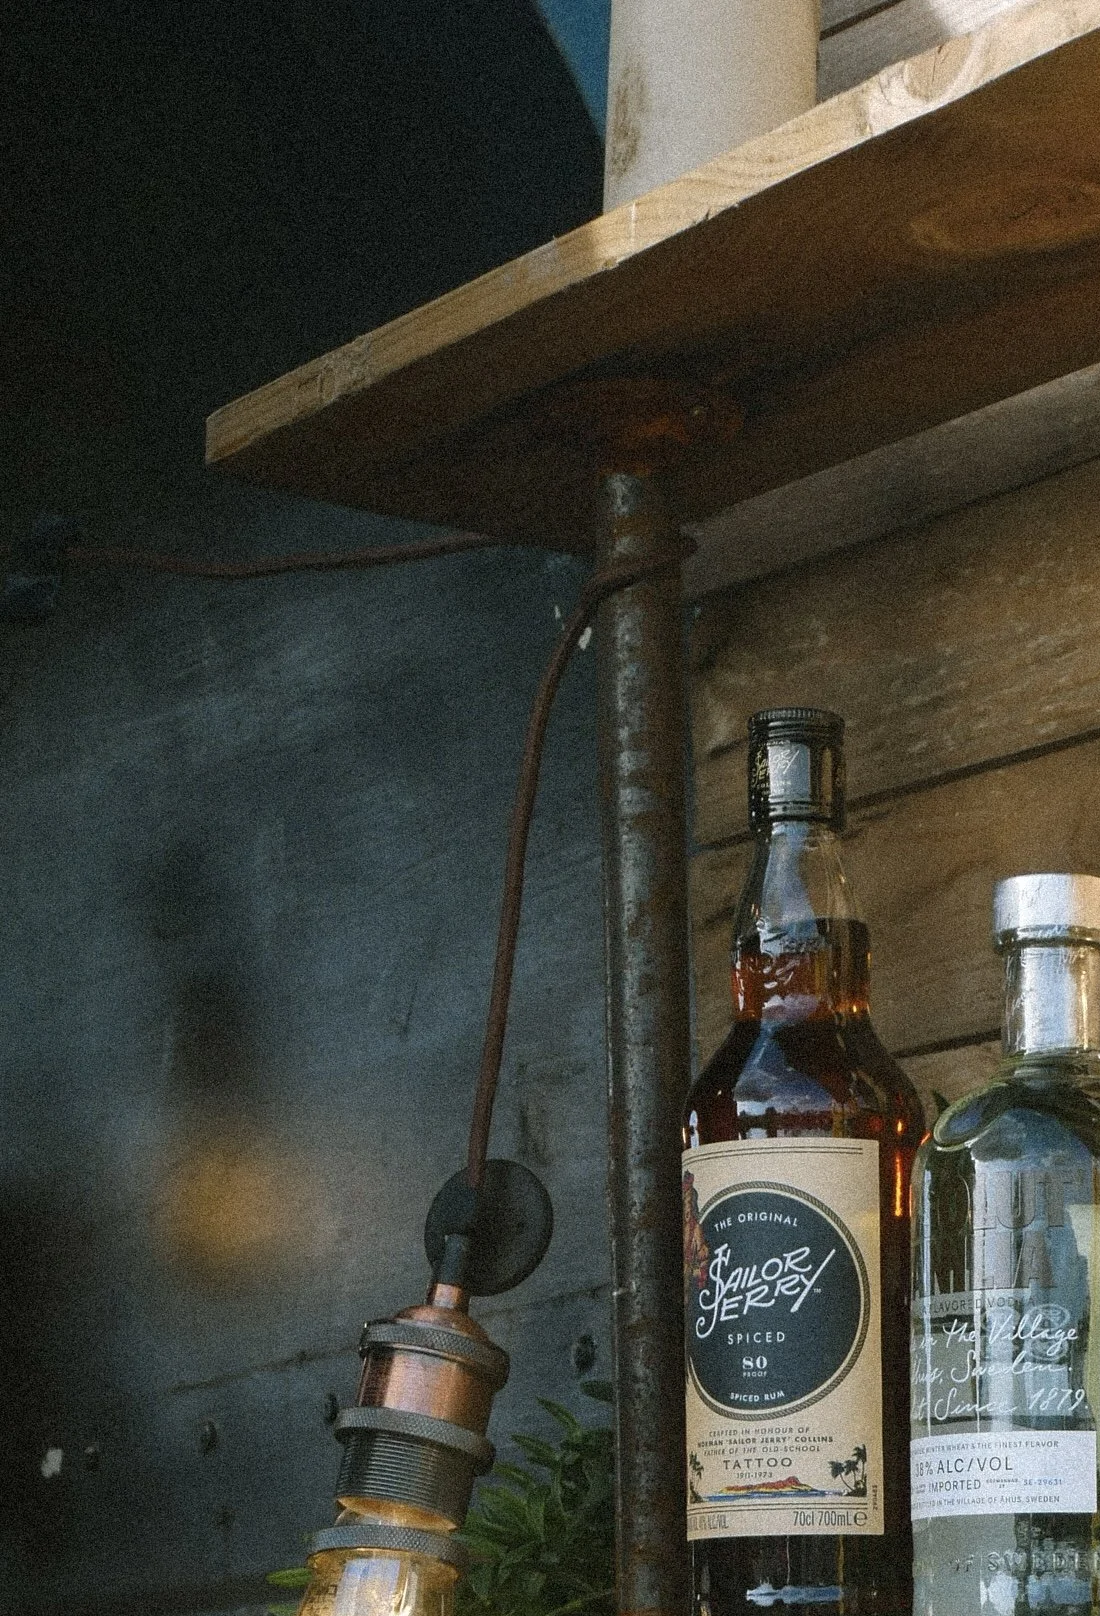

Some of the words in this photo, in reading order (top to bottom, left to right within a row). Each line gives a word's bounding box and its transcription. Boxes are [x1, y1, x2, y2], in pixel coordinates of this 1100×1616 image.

[714, 1217, 732, 1233] THE
[738, 1211, 798, 1228] ORIGINAL
[699, 1243, 813, 1311] SAILOR
[695, 1249, 836, 1340] JERRY
[728, 1331, 786, 1345] SPICED
[988, 1313, 1079, 1357] Village
[742, 1355, 768, 1370] 80
[950, 1350, 1074, 1383] Sweden.
[730, 1391, 759, 1402] SPICED
[764, 1389, 785, 1401] RUM
[1027, 1388, 1088, 1412] 1879.
[709, 1428, 738, 1438] CRAFTED
[741, 1428, 751, 1436] IN
[754, 1427, 793, 1435] HONOUR
[798, 1426, 811, 1434] OF
[795, 1435, 834, 1443] COLLINS
[704, 1448, 727, 1457] FATHER
[729, 1447, 740, 1455] OF
[743, 1446, 757, 1454] THE
[947, 1443, 969, 1453] WHEAT
[978, 1441, 992, 1450] THE
[995, 1440, 1022, 1449] FINEST
[1025, 1440, 1059, 1448] FLAVOR
[722, 1457, 793, 1471] TATTOO
[937, 1455, 1013, 1475] ALC/VOL
[929, 1479, 982, 1494] IMPORTED
[944, 1498, 955, 1506] THE
[957, 1497, 986, 1505] VILLAGE
[988, 1496, 998, 1504] OF
[1026, 1495, 1060, 1503] SWEDEN
[793, 1511, 815, 1526] 70cl
[818, 1510, 852, 1527] 700mL
